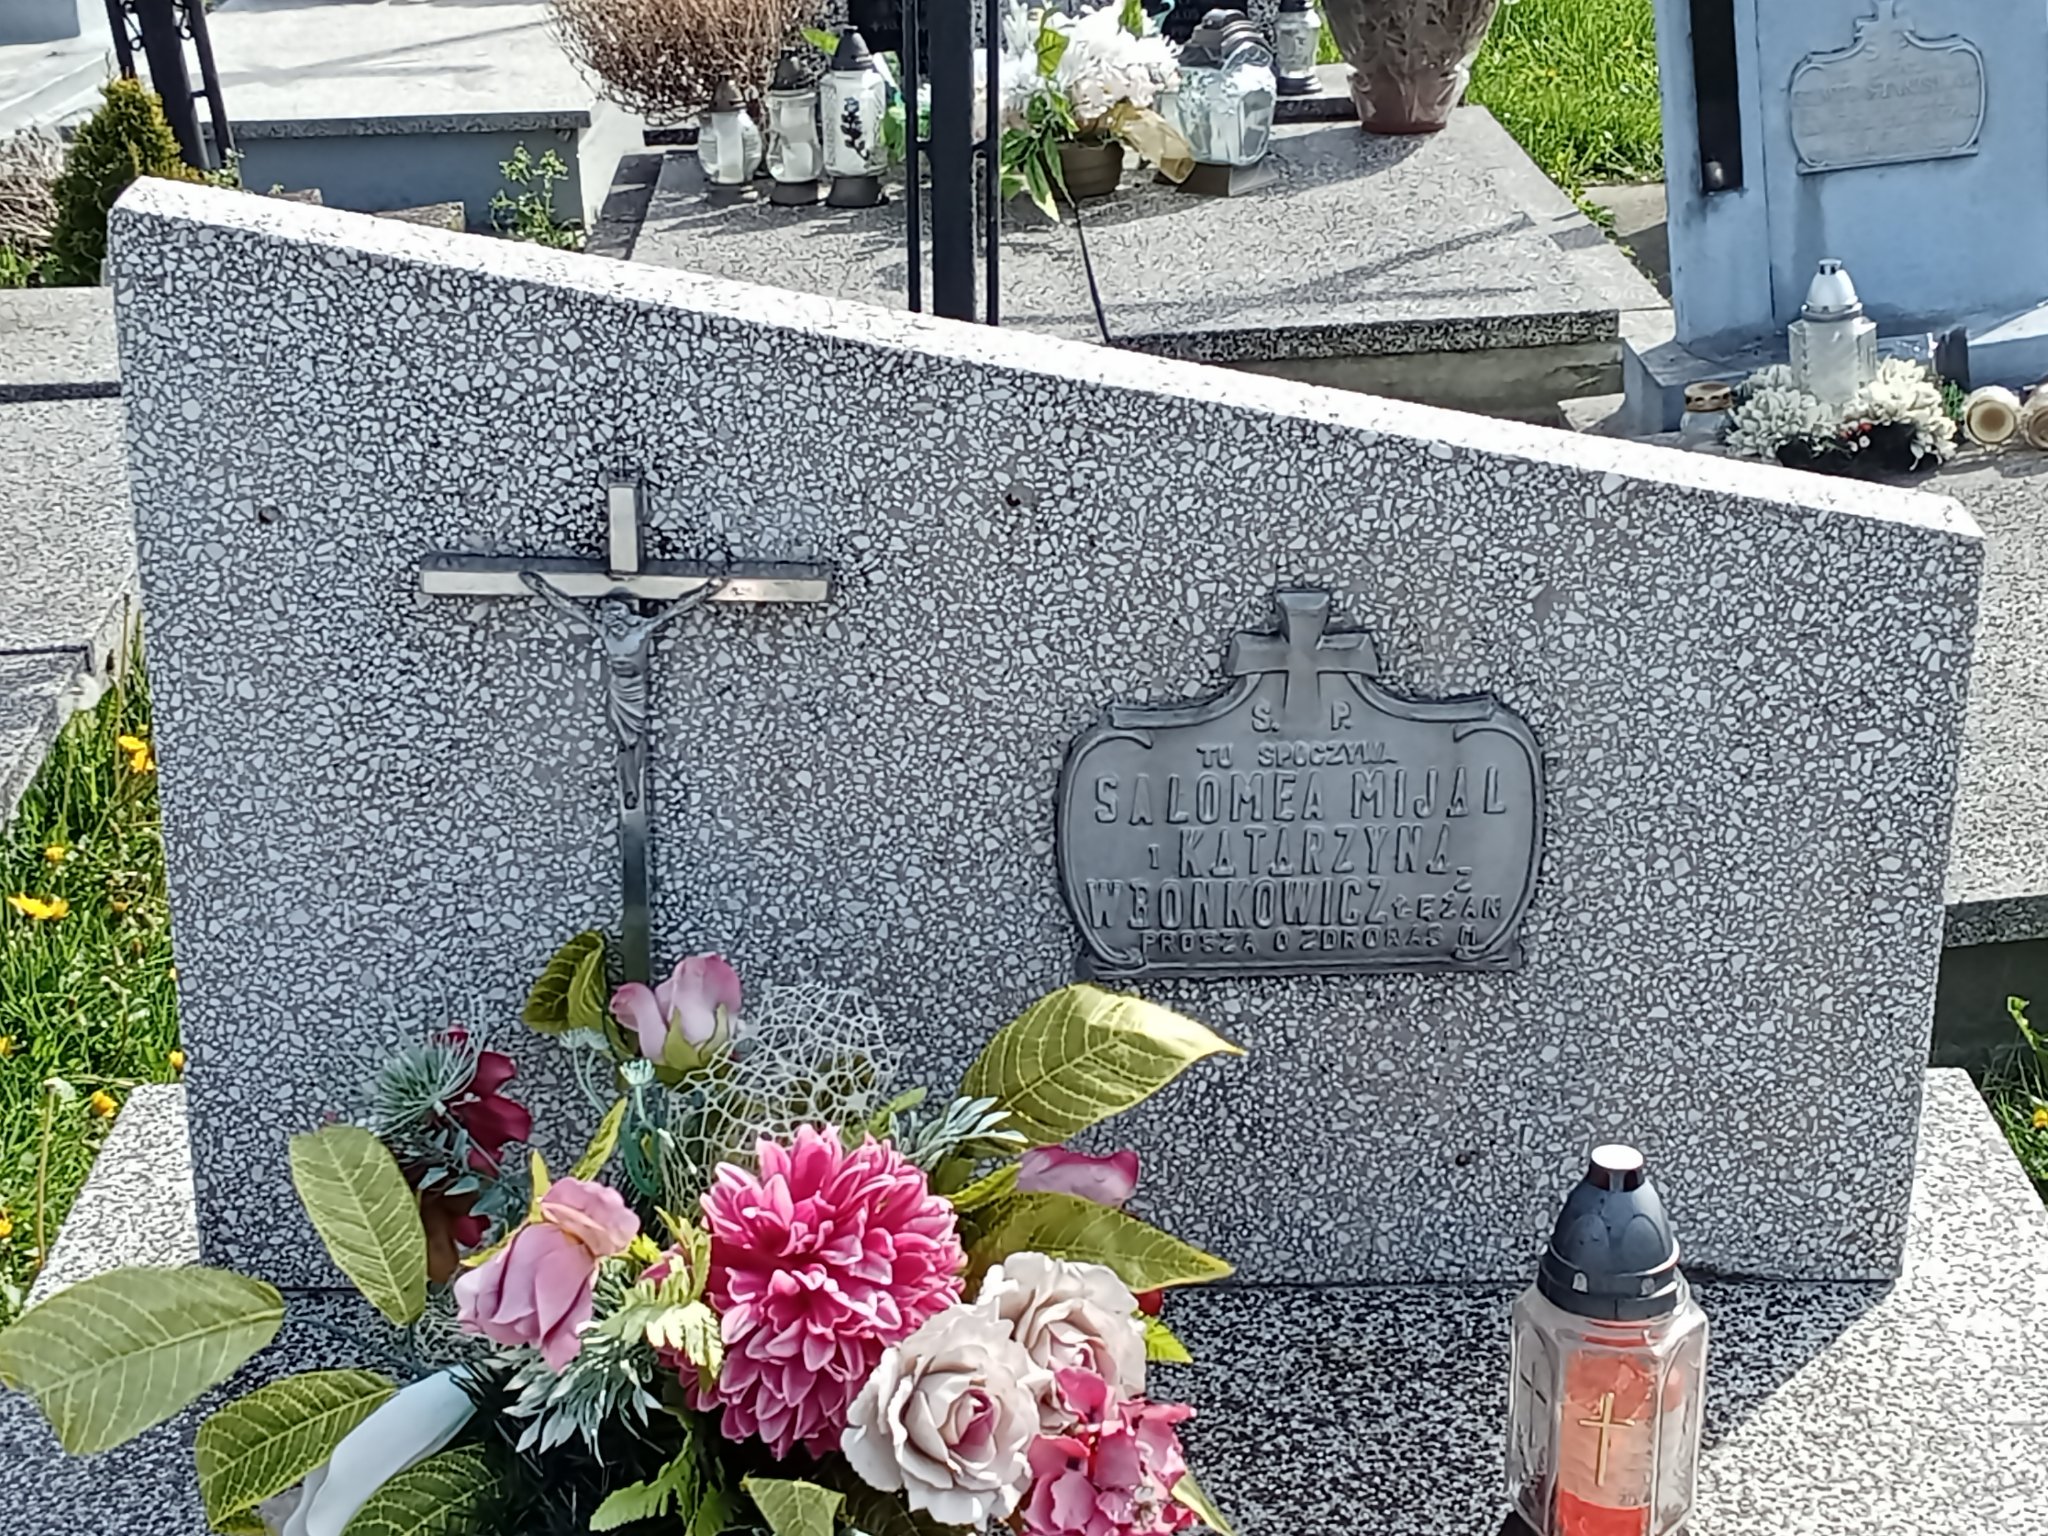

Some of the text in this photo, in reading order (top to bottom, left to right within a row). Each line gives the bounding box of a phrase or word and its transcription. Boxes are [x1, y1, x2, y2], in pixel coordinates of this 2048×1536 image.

[1196, 743, 1234, 768] TU
[1094, 765, 1506, 826] SALOMEA MIJAL
[1179, 823, 1449, 878] KATARZYNA
